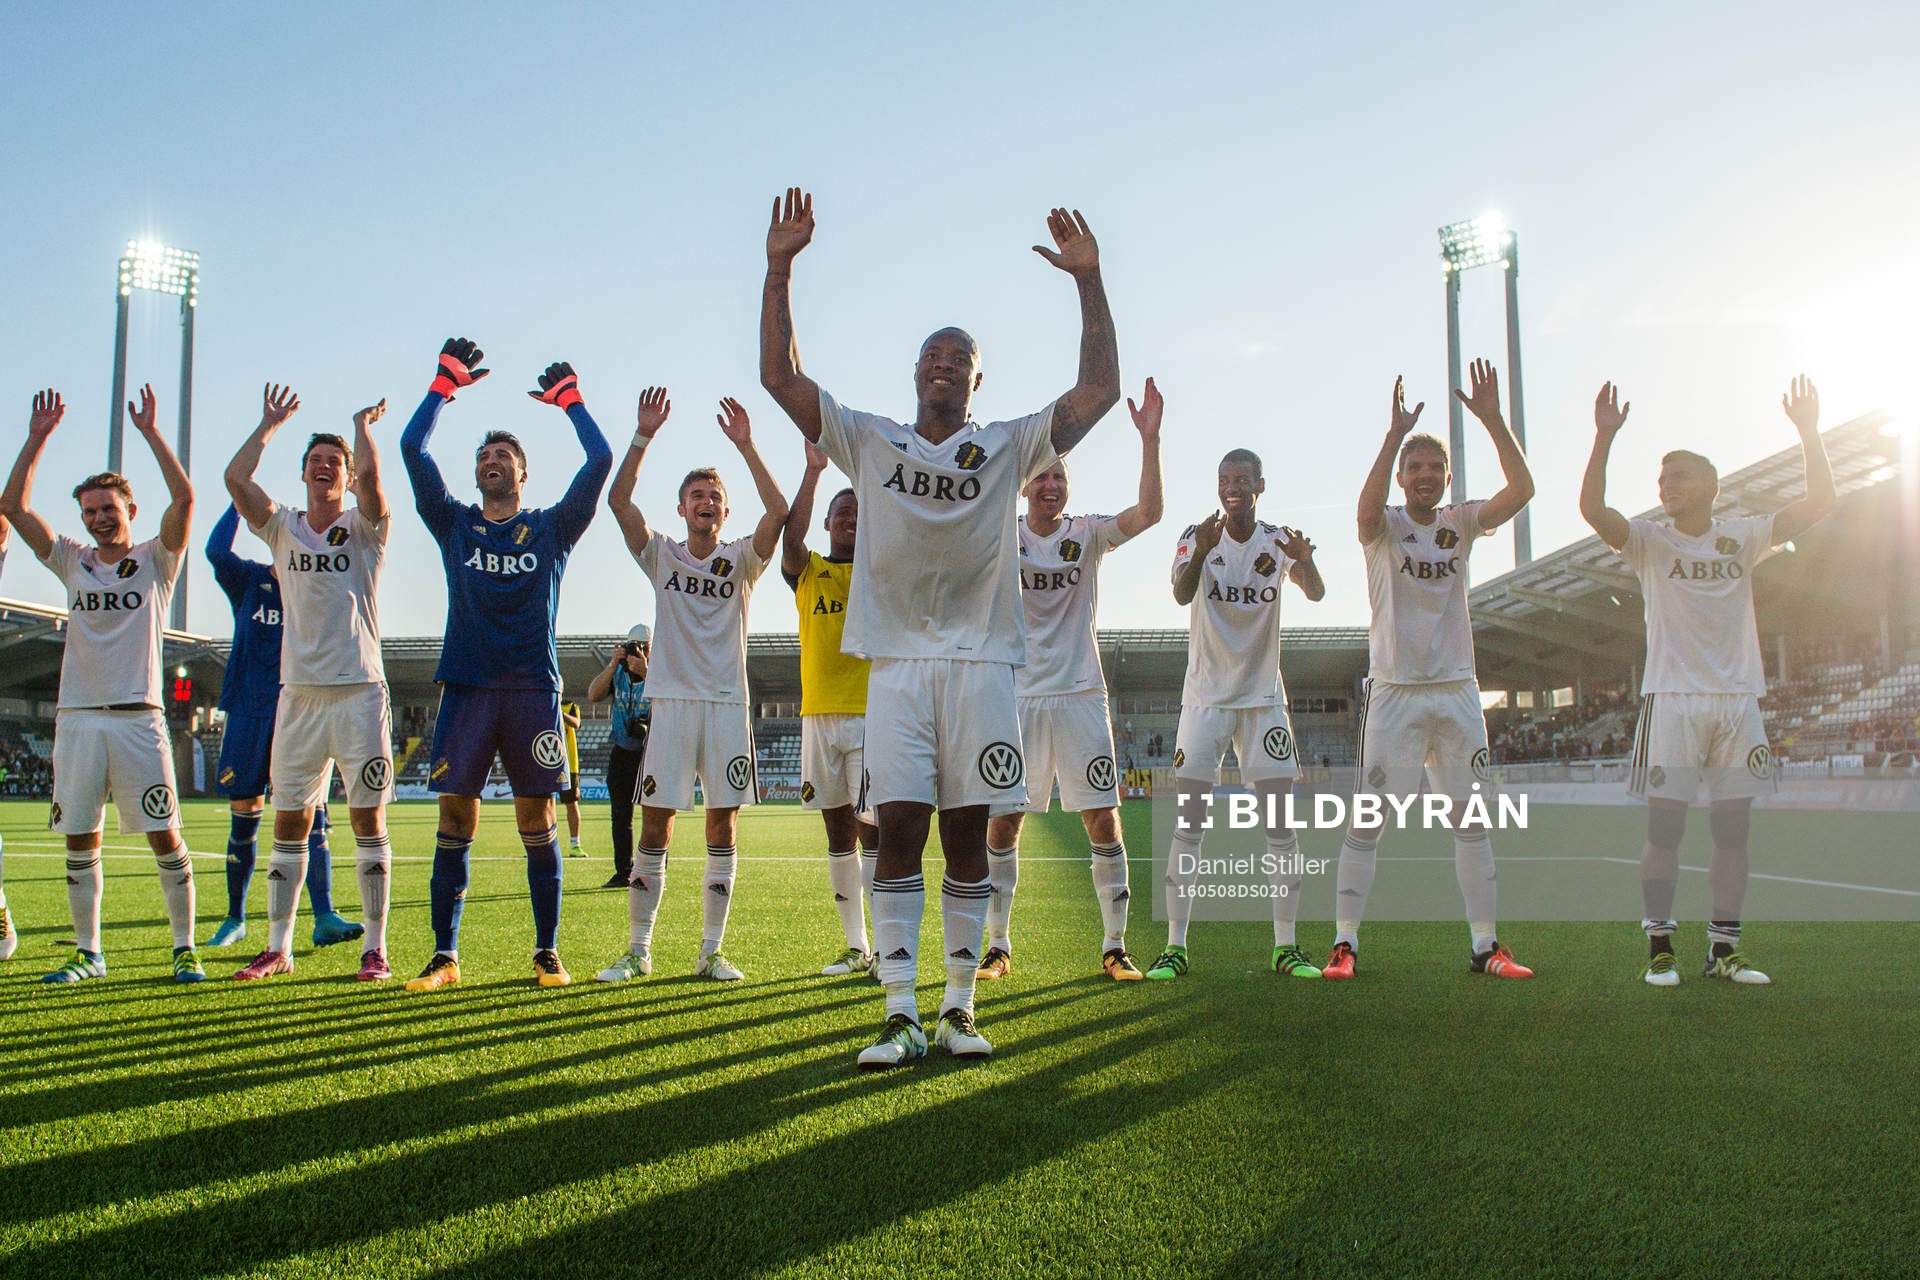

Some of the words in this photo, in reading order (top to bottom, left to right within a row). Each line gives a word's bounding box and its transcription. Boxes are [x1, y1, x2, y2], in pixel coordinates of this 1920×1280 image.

[883, 463, 981, 501] ÅBRO
[288, 550, 350, 572] ÅBRO
[465, 548, 538, 574] ÅBRO
[1668, 558, 1743, 580] ÅBRO
[664, 571, 734, 598] ÅBRO
[1208, 581, 1277, 604] ÅBRO
[72, 590, 142, 611] ÅBRO
